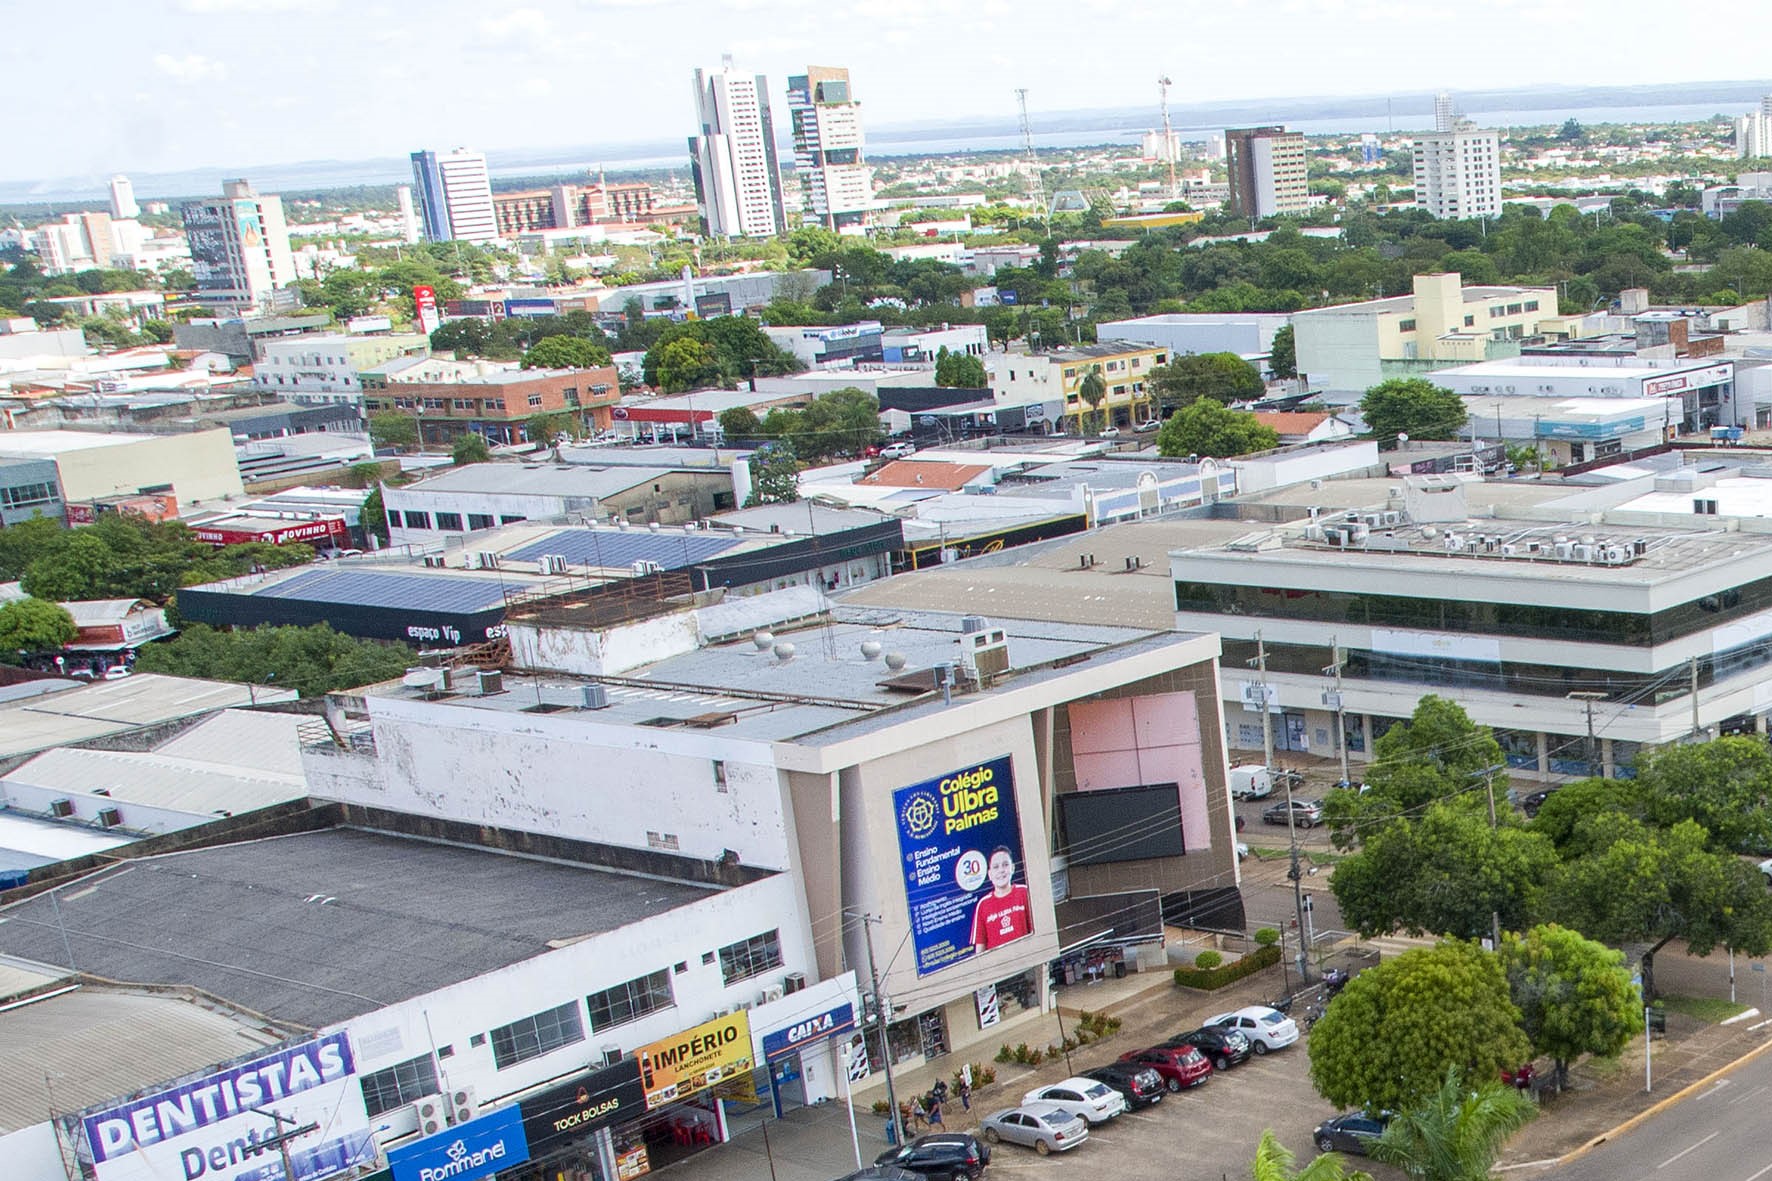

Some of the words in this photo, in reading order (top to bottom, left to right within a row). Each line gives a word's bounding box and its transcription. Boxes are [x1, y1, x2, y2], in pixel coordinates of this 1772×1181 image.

[407, 626, 439, 641] espaço
[442, 625, 461, 645] Vip
[940, 766, 993, 795] Colégio
[942, 785, 999, 818] Ulbra
[945, 806, 999, 836] Palmas
[914, 846, 938, 860] Ensino
[915, 846, 961, 869] Fundamental
[917, 864, 941, 878] Ensino
[918, 873, 941, 887] Médio
[963, 859, 981, 876] 30
[788, 1013, 835, 1043] CAIXA
[653, 1025, 738, 1071] IMPÉRIO
[674, 1050, 722, 1073] LANCHONETE
[97, 1043, 345, 1151] DENTISTAS
[553, 1114, 581, 1132] TOCK
[582, 1098, 620, 1122] BOLSAS
